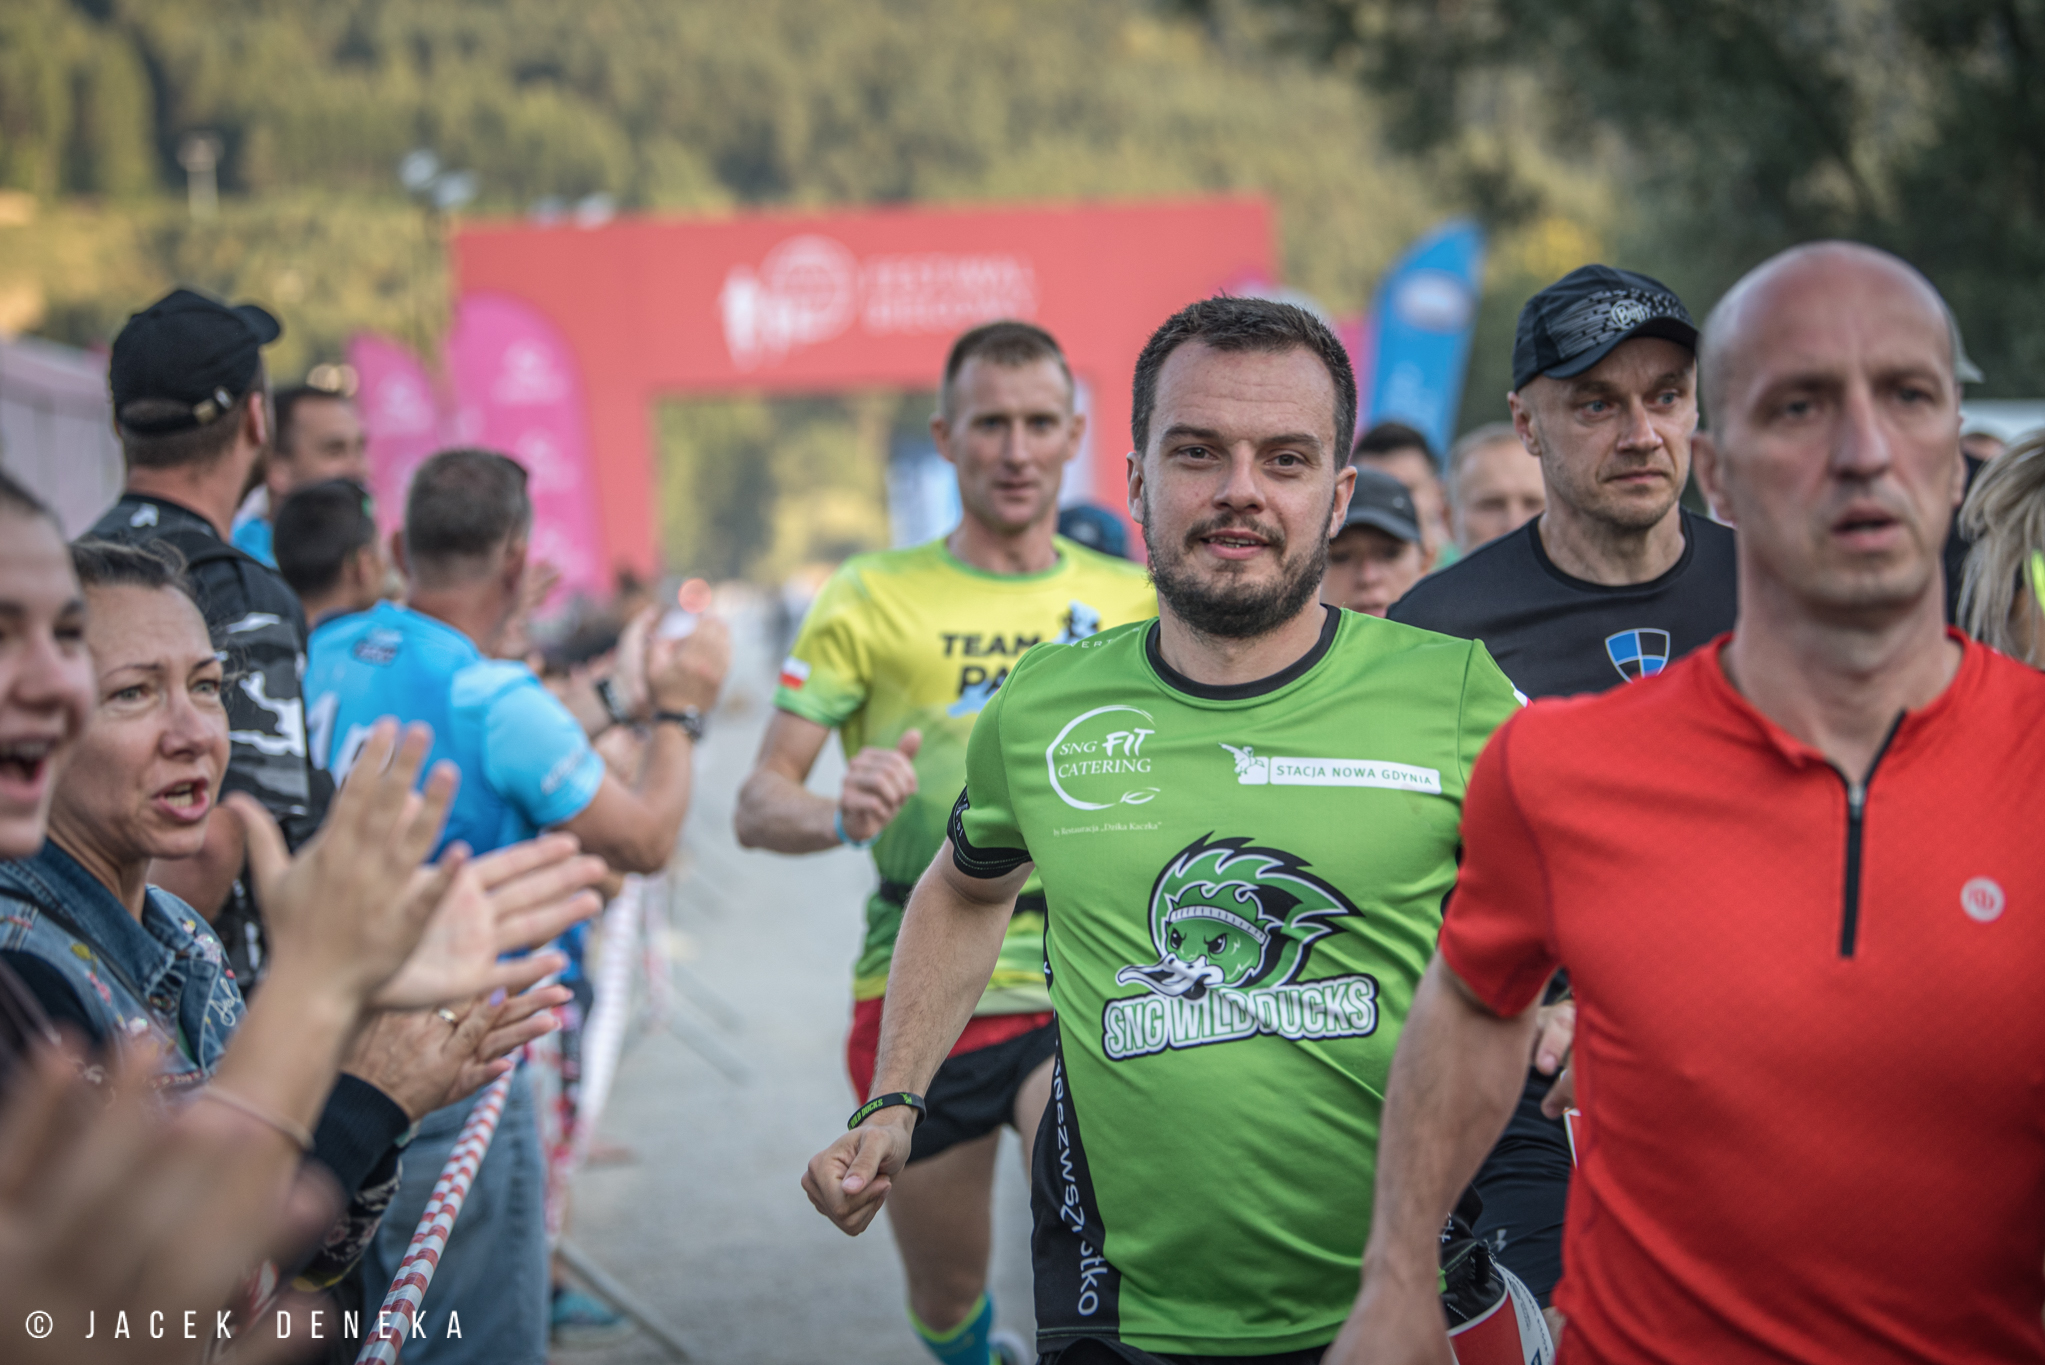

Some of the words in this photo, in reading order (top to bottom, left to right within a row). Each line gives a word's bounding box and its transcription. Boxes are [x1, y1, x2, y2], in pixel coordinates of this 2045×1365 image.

[940, 632, 1042, 657] TEAM
[1059, 740, 1098, 756] SNG
[1102, 728, 1155, 757] FIT
[1058, 758, 1152, 778] CATERING
[1276, 765, 1326, 779] STACJA
[1332, 767, 1376, 779] NOWA
[1382, 769, 1433, 786] GDYNIA
[1106, 998, 1167, 1054] SNG
[1169, 988, 1256, 1045] WILD
[1252, 977, 1373, 1037] DUCKS
[861, 1098, 884, 1118] DUCKS
